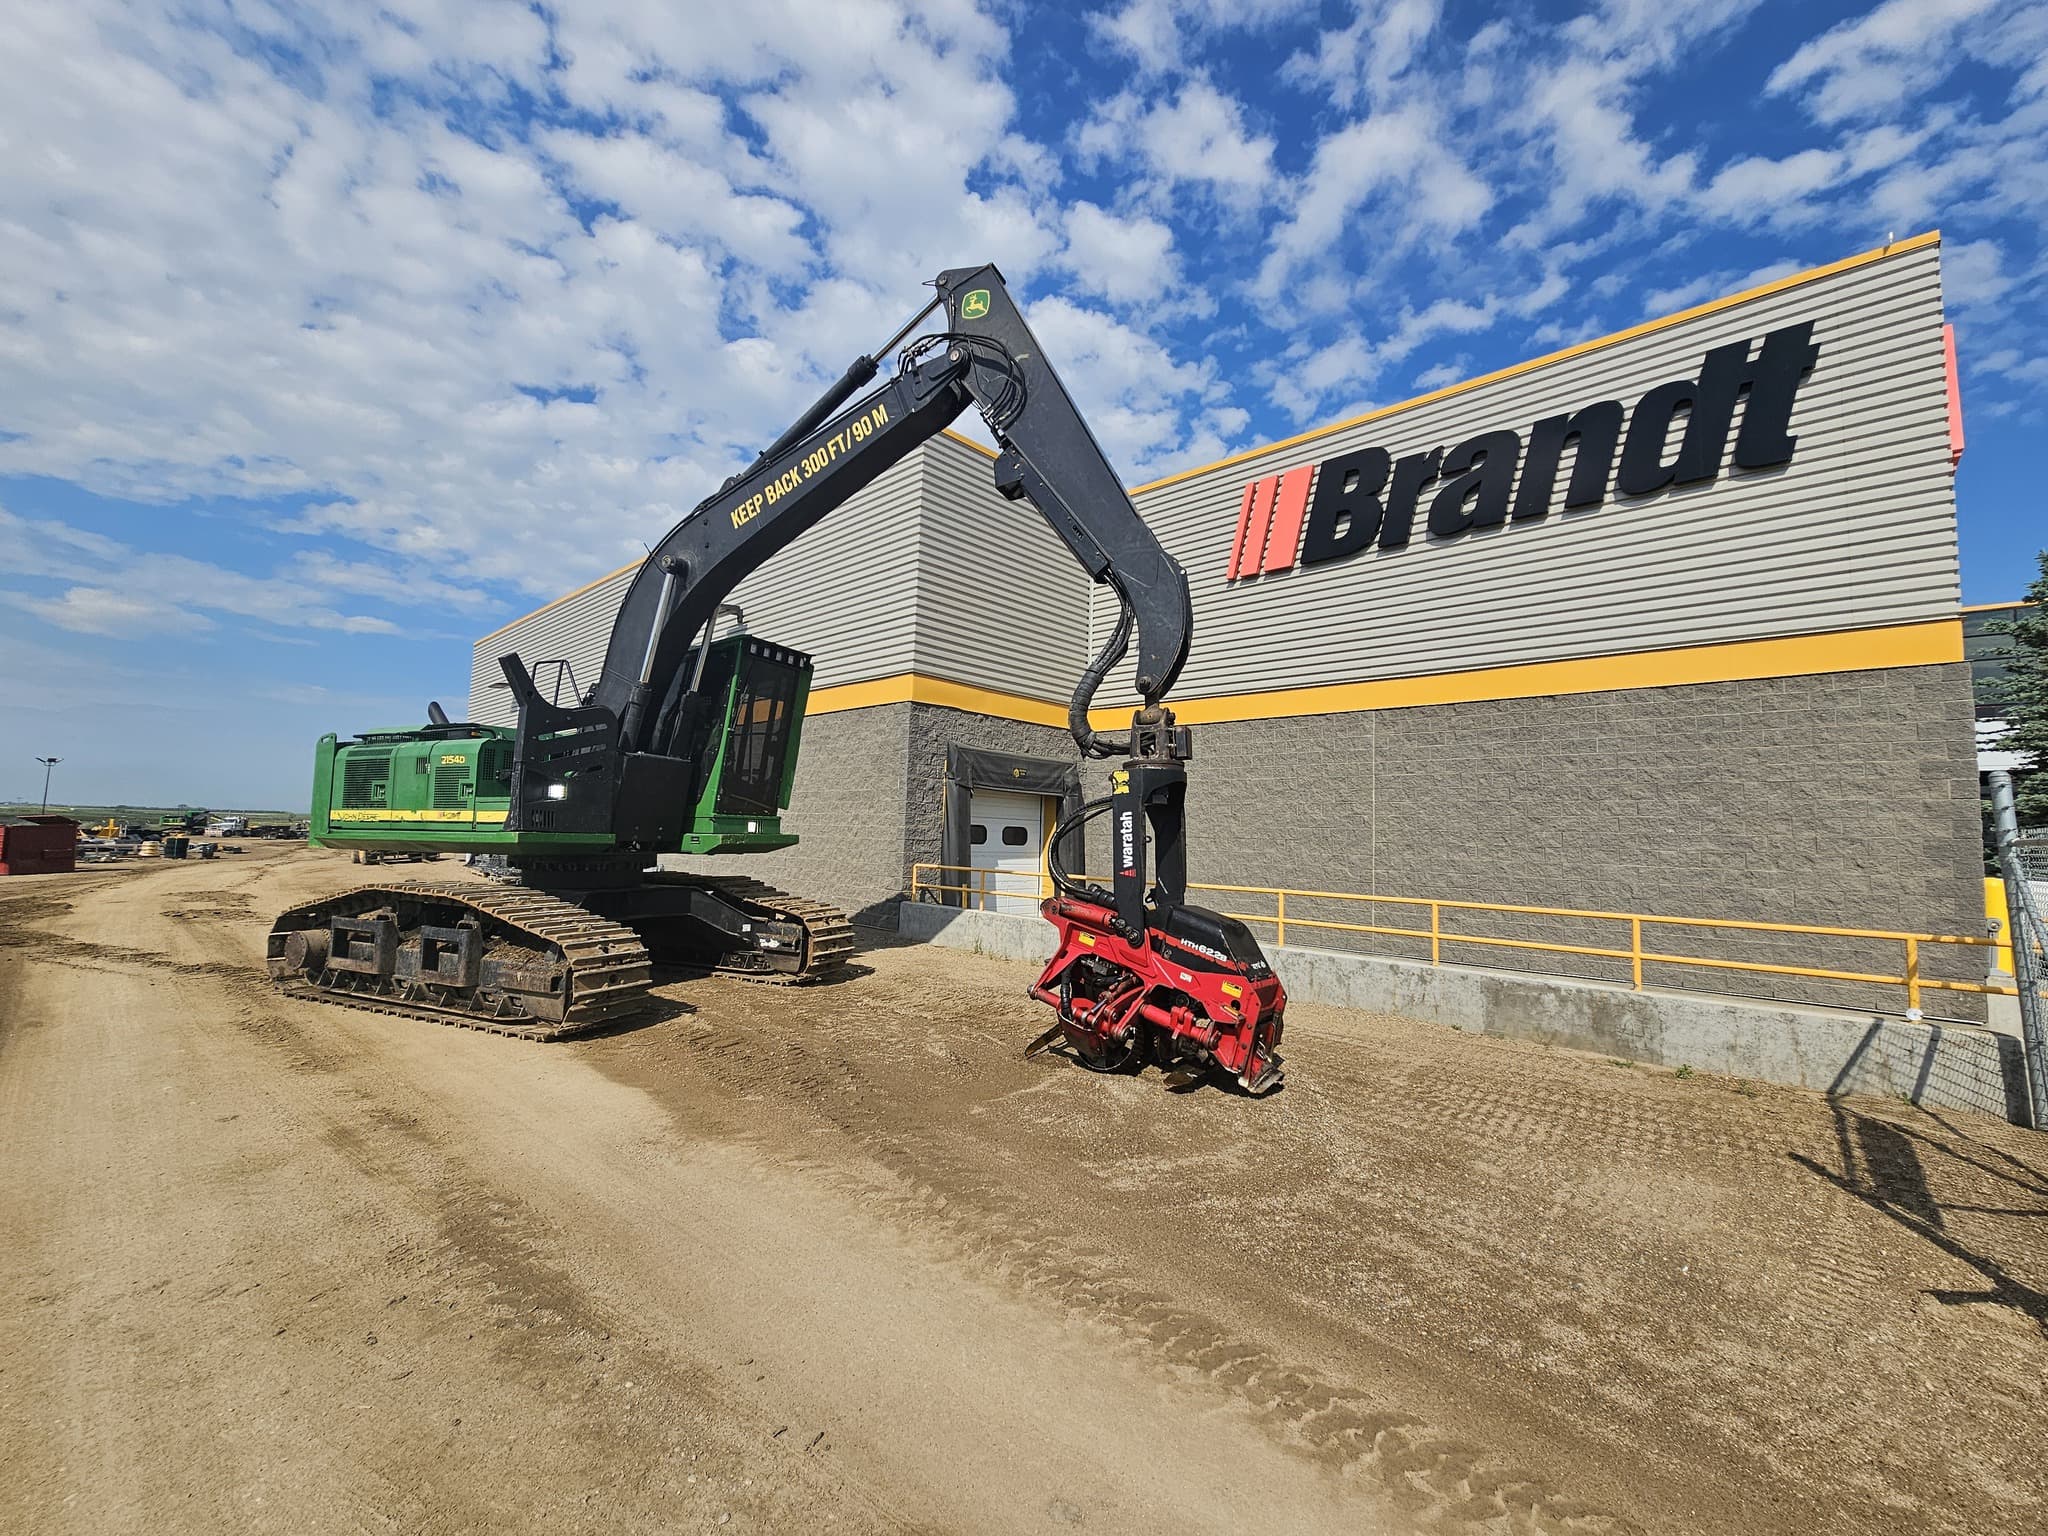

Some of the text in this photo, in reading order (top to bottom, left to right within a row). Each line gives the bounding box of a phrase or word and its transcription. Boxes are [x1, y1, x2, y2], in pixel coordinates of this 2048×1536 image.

[730, 493, 764, 529] KEEP
[764, 466, 803, 505] BACK
[801, 447, 829, 479] 300
[871, 403, 889, 429] M
[1300, 319, 1821, 566] Brandt
[1120, 811, 1134, 868] waratah
